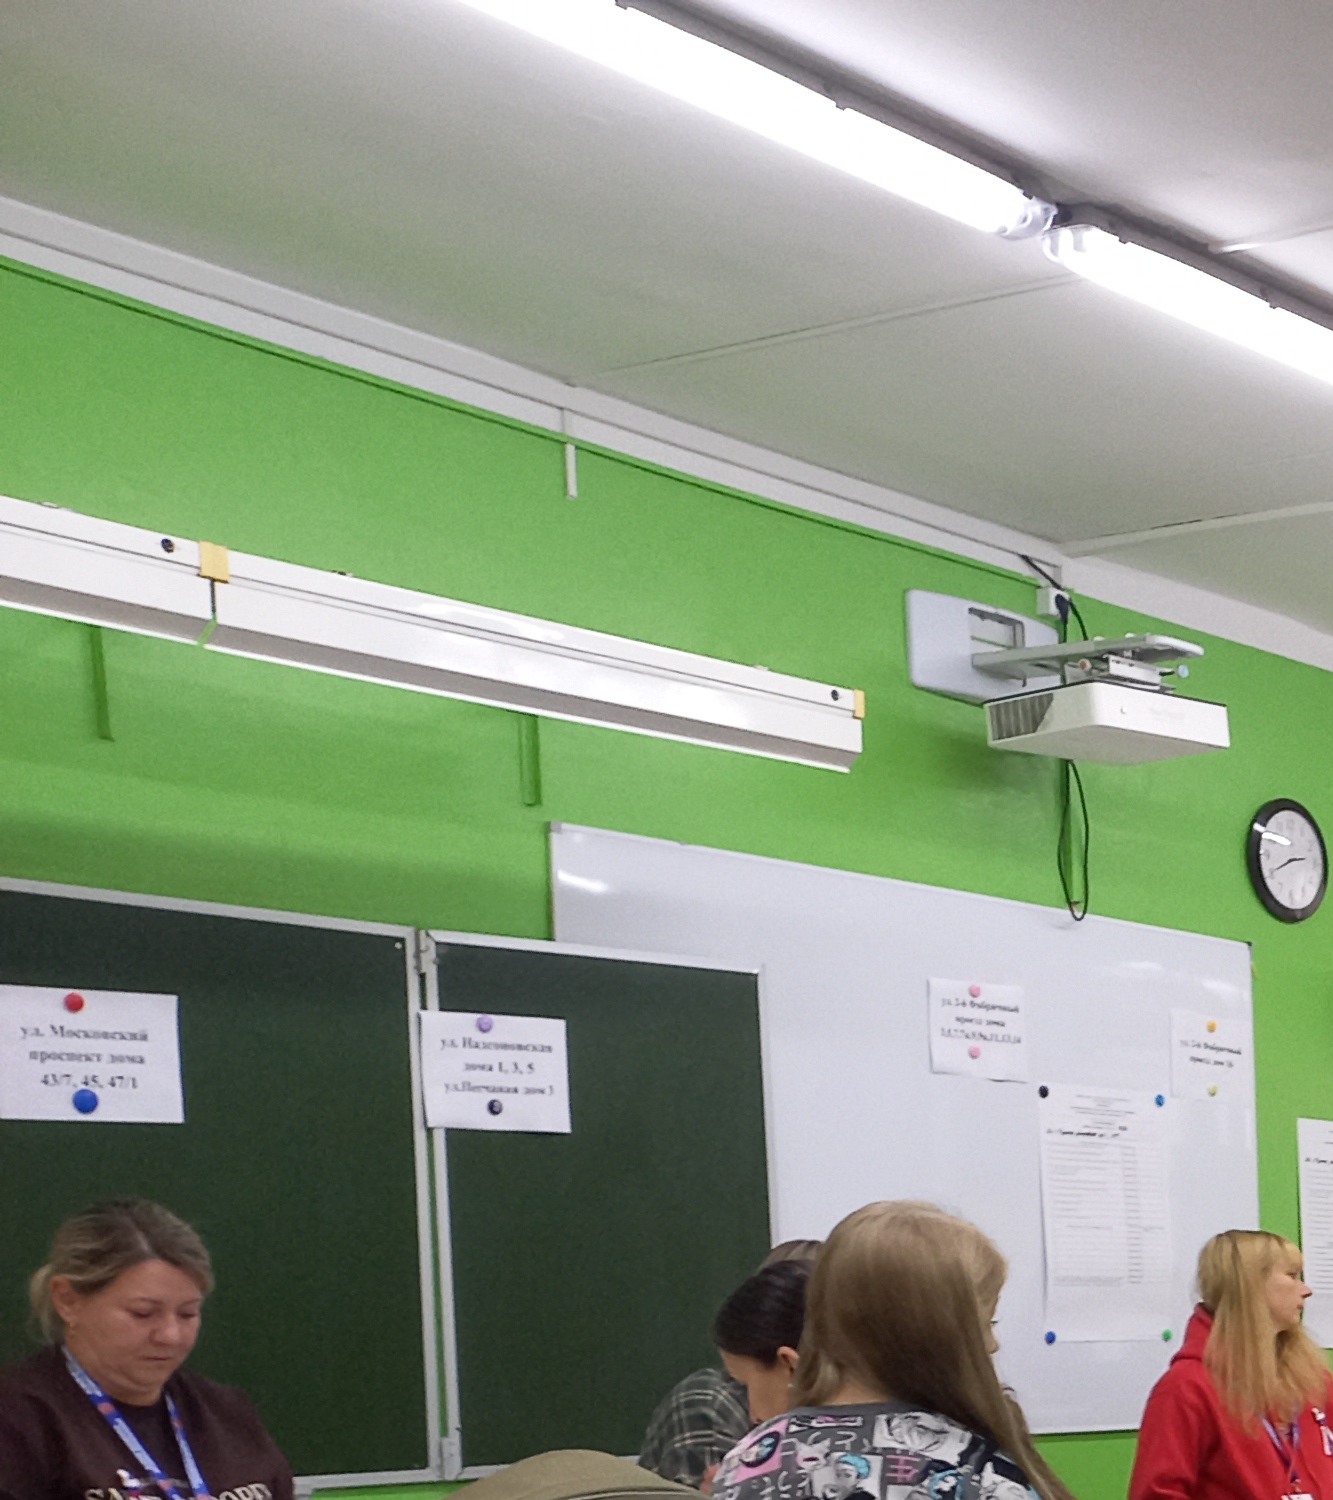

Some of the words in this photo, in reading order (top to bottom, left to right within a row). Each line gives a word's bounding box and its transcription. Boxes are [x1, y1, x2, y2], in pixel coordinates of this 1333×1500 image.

[50, 1024, 149, 1042] Московский
[29, 1050, 102, 1064] проспект
[107, 1053, 145, 1065] дома
